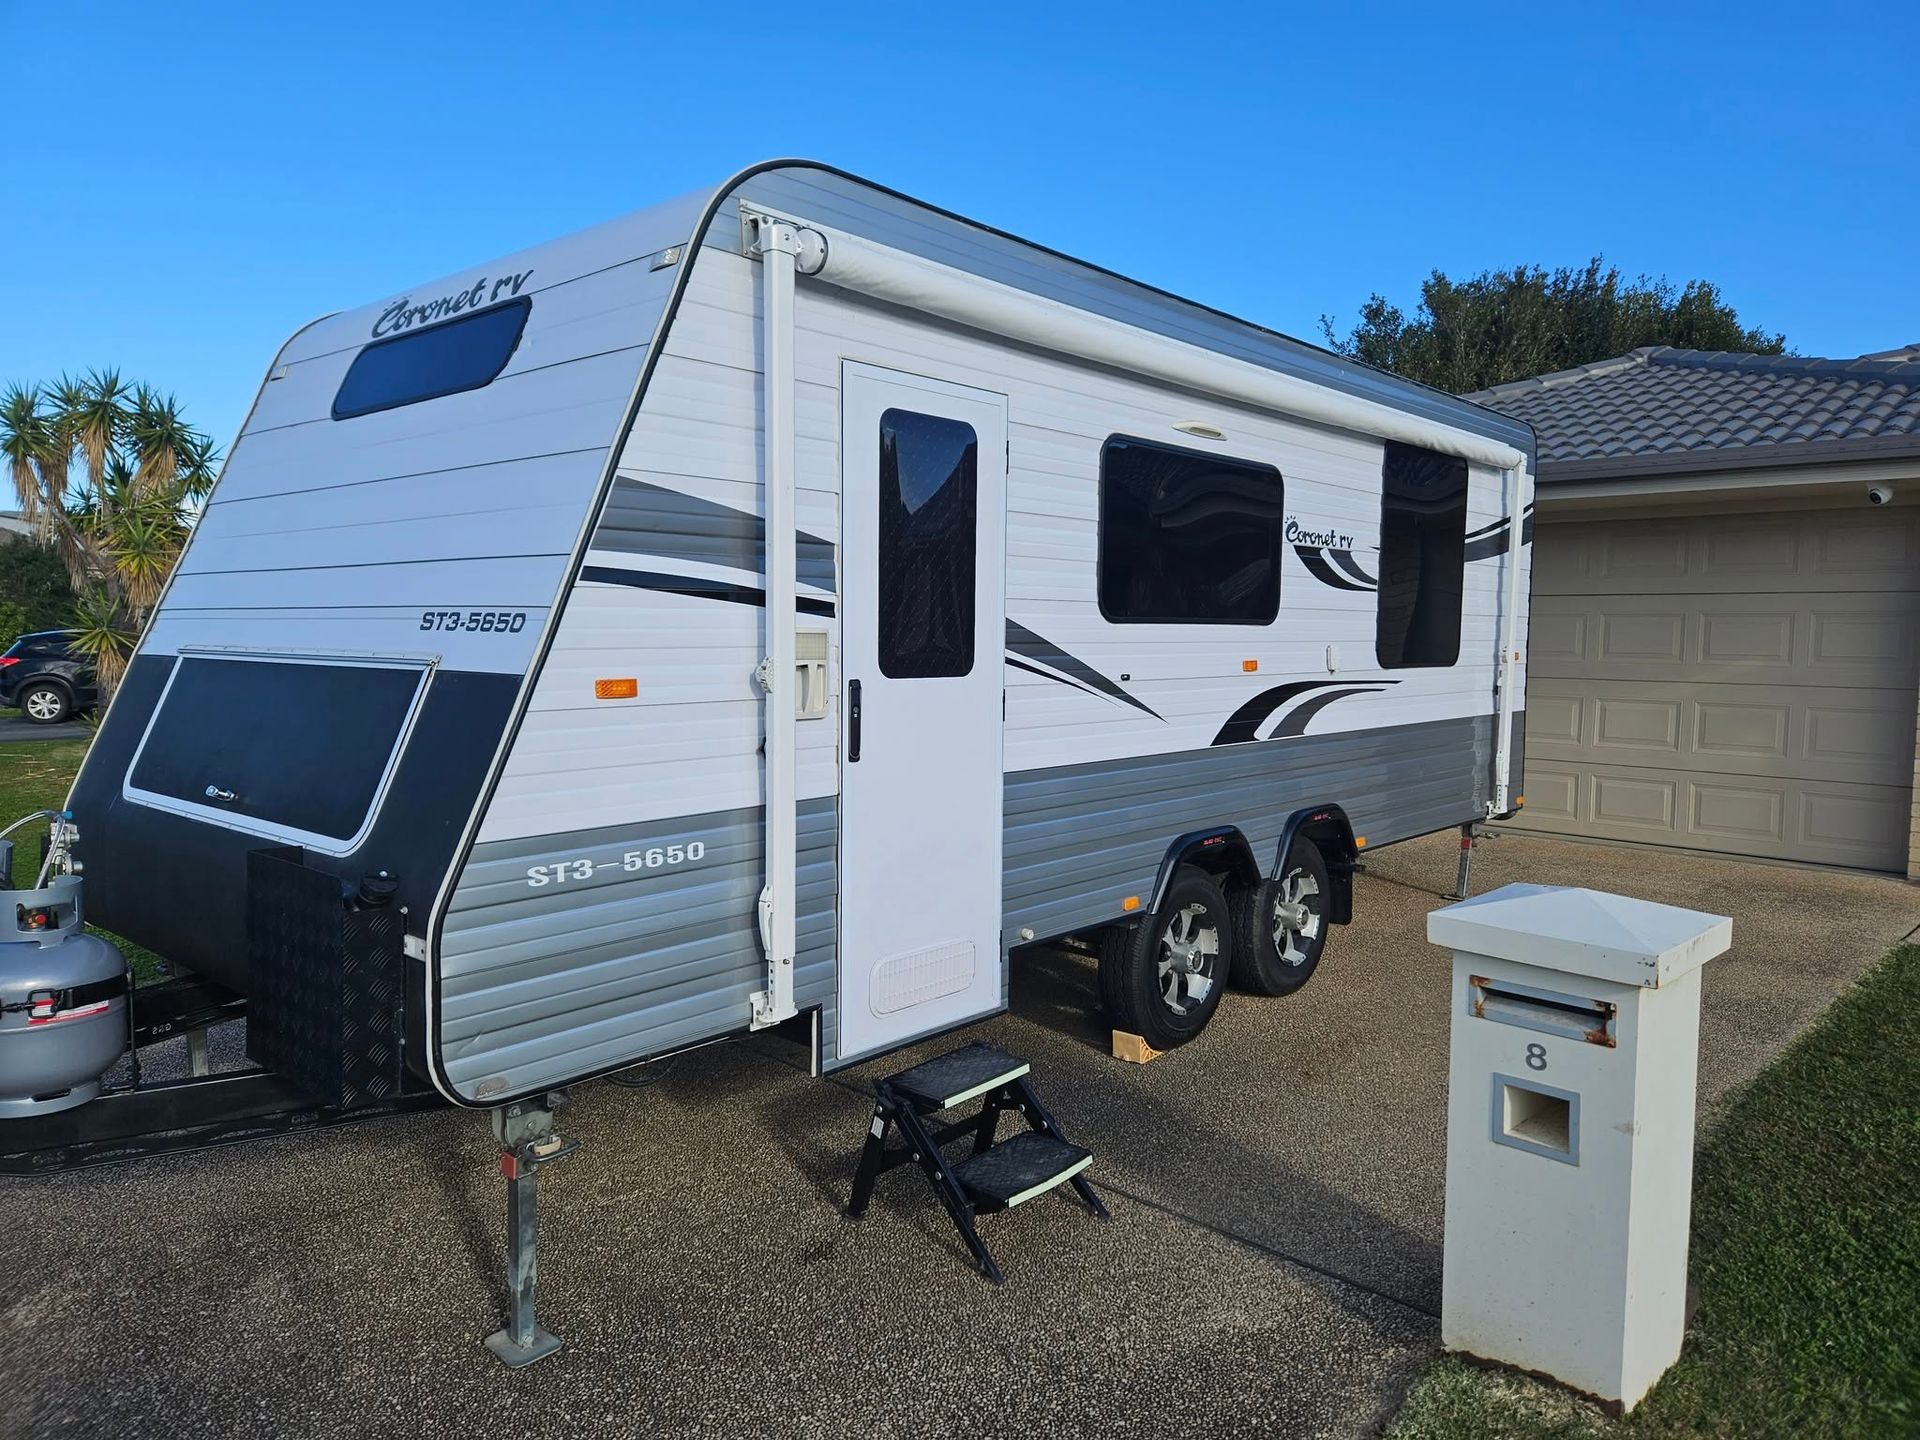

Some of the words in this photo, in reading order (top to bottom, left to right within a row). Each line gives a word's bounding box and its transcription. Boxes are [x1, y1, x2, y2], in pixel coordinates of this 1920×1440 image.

[372, 277, 487, 338] Coronet
[490, 269, 535, 302] rv
[1285, 518, 1336, 547] Coronet
[1340, 534, 1354, 548] rv
[420, 611, 526, 633] ST3-5650
[1525, 1043, 1547, 1071] 8
